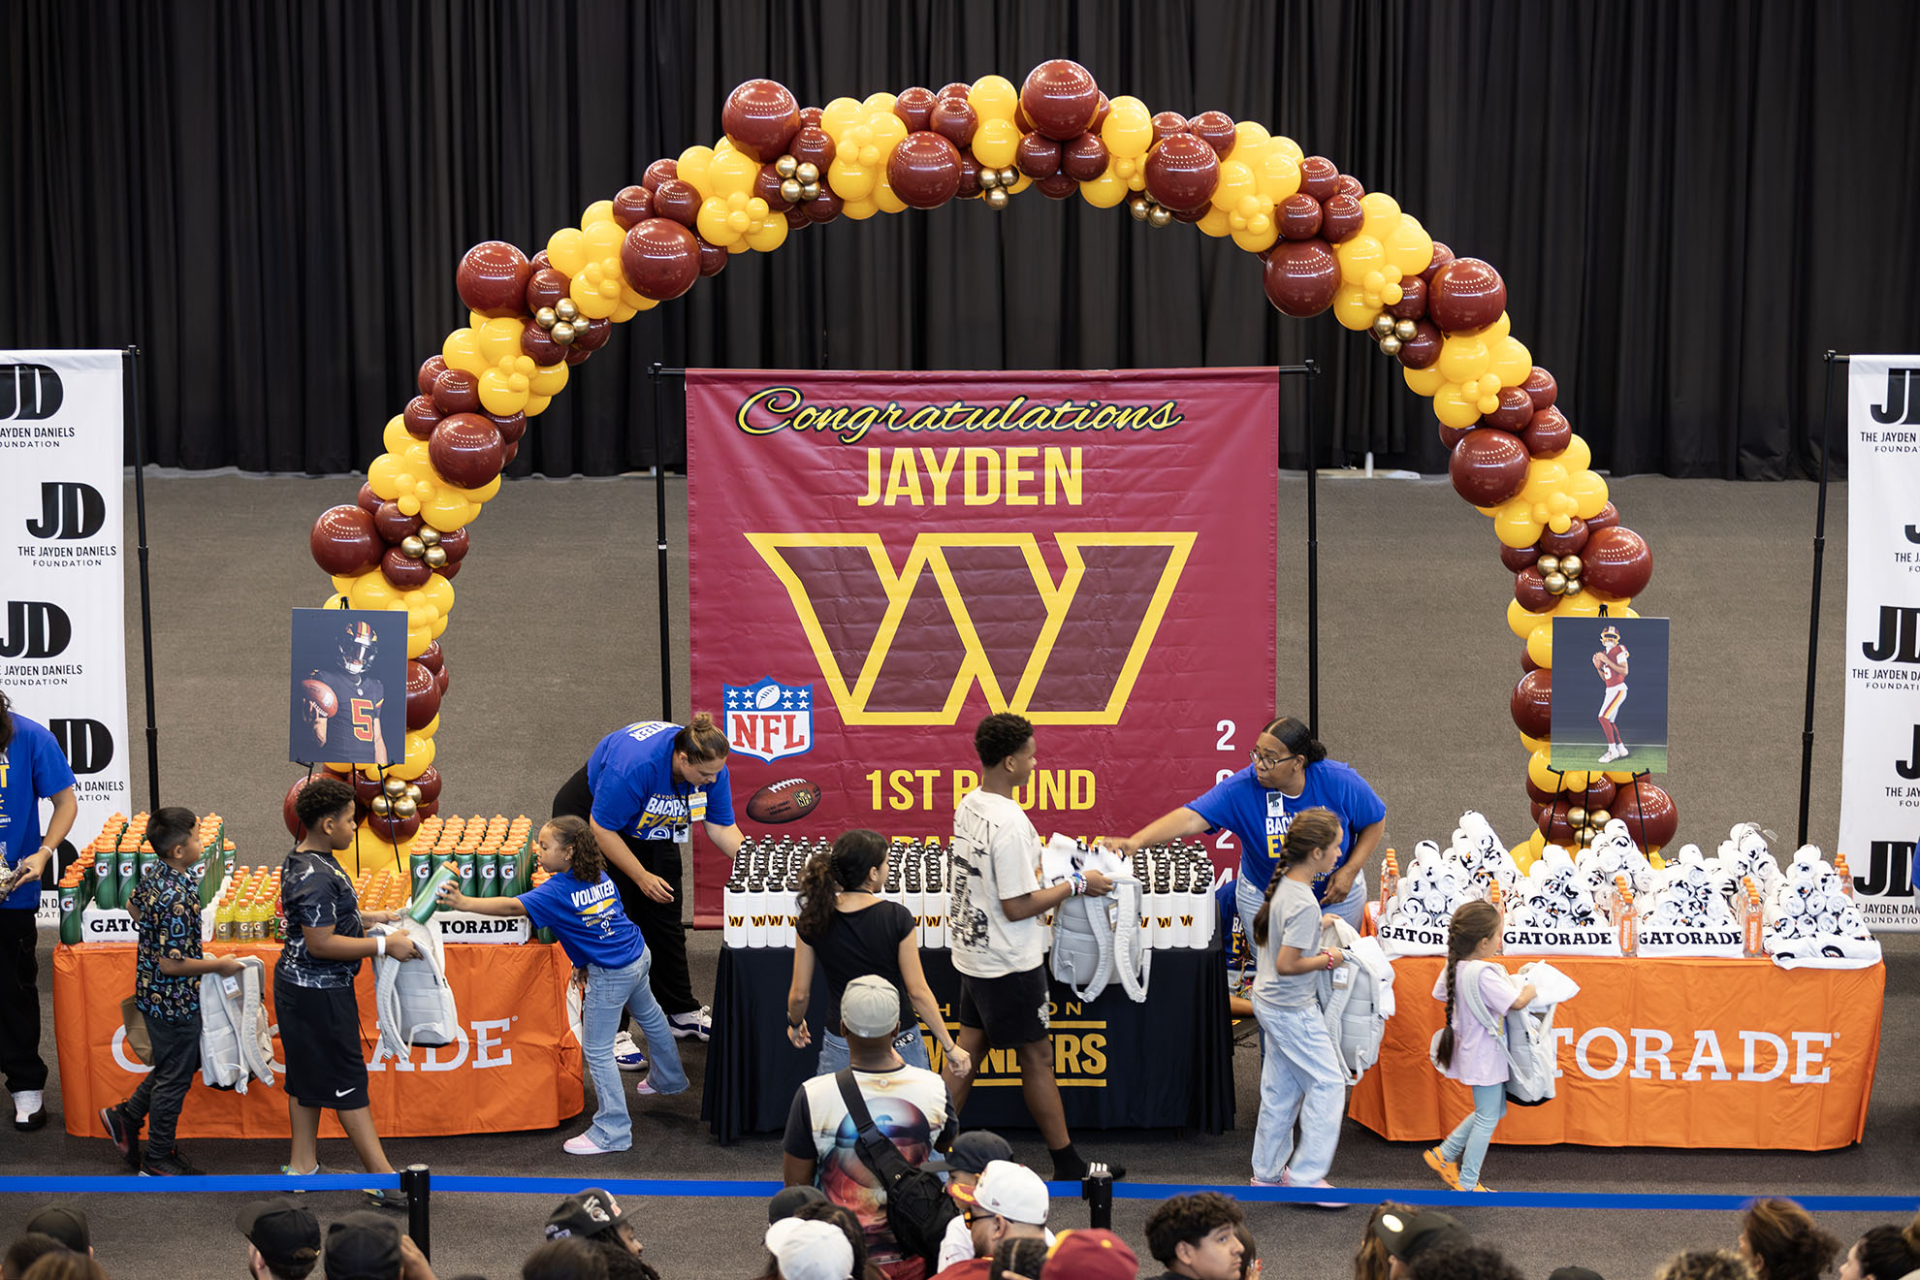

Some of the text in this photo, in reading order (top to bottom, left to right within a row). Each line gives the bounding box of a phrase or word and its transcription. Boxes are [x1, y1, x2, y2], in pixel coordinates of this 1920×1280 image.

[735, 386, 1185, 444] Congratulations
[0, 427, 75, 438] AYDEN DANIELS
[1860, 432, 1917, 443] THE JAYDEN
[857, 447, 1083, 506] JAYDEN
[26, 482, 106, 540] JD
[18, 546, 117, 557] THE JAYDEN DANIELS
[1894, 553, 1912, 562] THE
[33, 559, 102, 567] FOUNDATION
[4, 664, 83, 676] JAYDEN DANIELS
[1853, 669, 1869, 679] THE
[1872, 669, 1908, 680] JAYDEN
[350, 698, 374, 741] 5
[731, 713, 805, 755] NFL
[84, 781, 124, 791] DANIELS
[866, 769, 1096, 811] 1ST RUND
[1885, 787, 1903, 797] THE
[1863, 904, 1898, 914] JAYDEN
[440, 918, 519, 934] TORADE
[1380, 925, 1444, 945] GATOR
[1503, 931, 1612, 945] GATORADE
[1639, 931, 1743, 945] GATORADE
